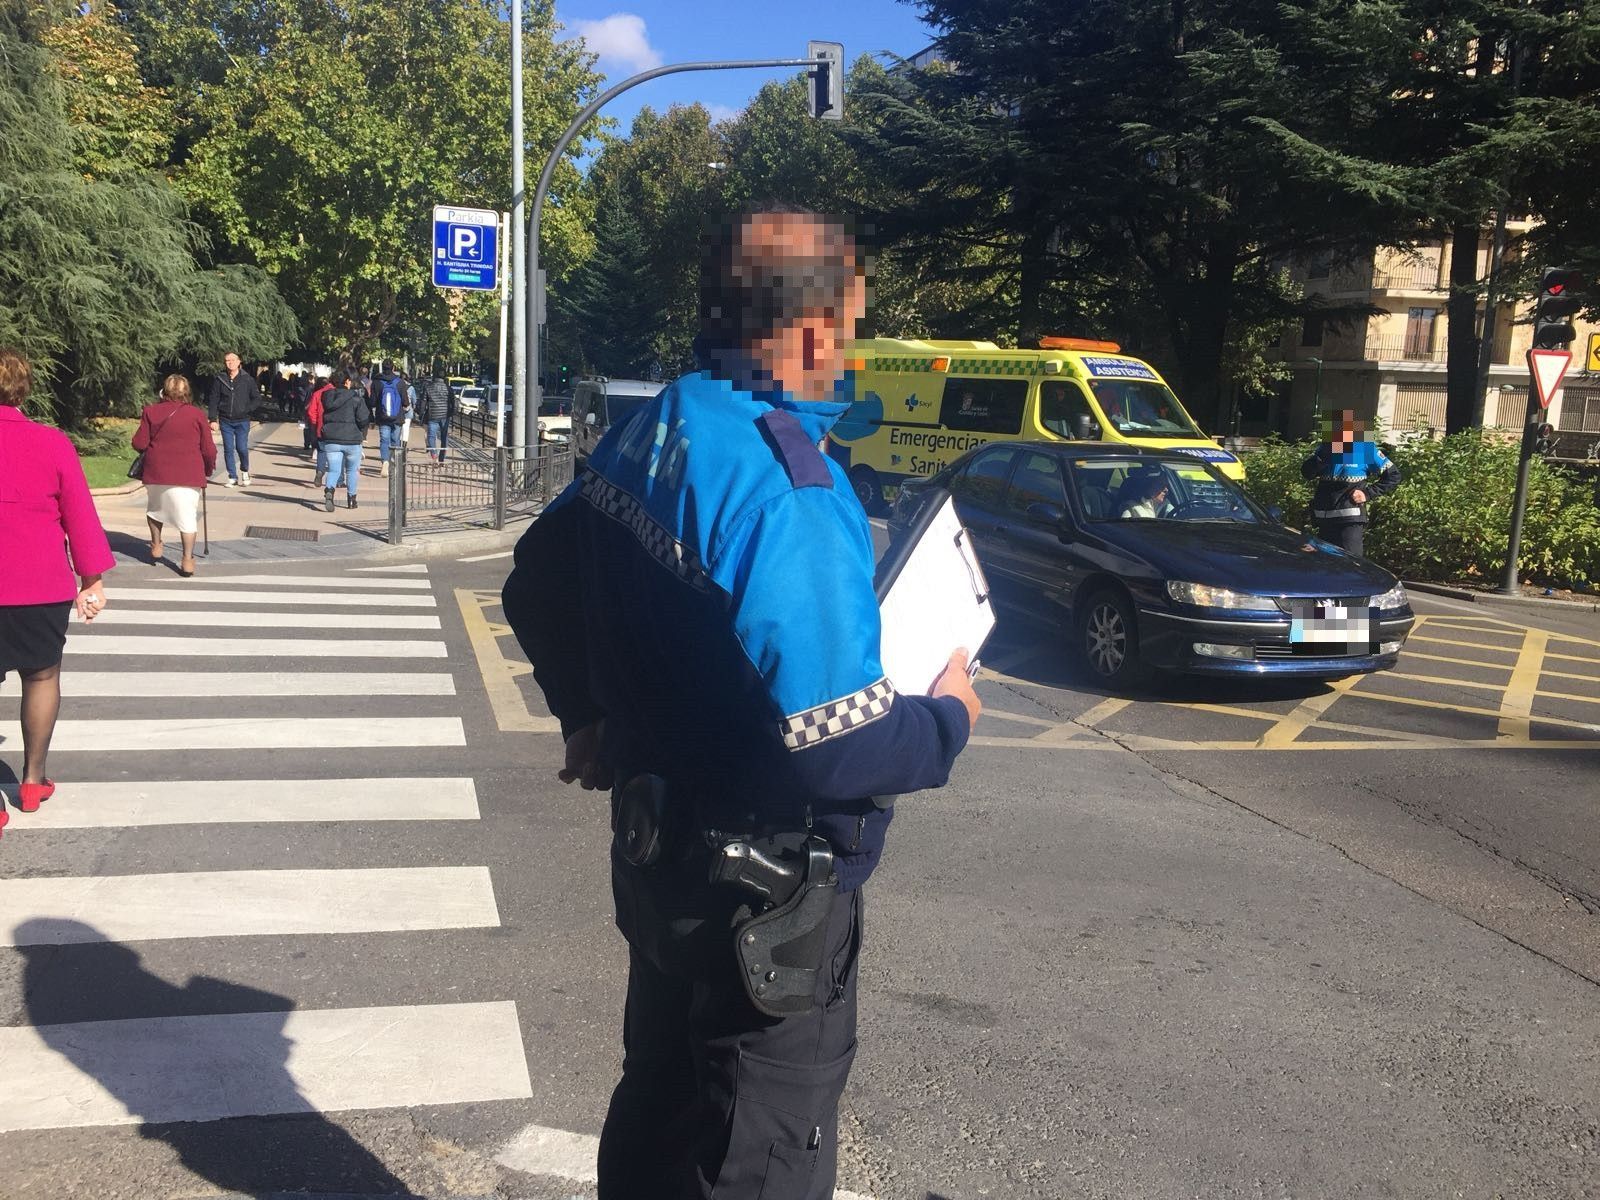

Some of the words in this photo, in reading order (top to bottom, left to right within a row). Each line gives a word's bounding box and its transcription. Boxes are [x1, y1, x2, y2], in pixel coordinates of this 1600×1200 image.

[447, 210, 484, 224] Parkia
[454, 227, 477, 257] P
[909, 455, 948, 475] Sanit
